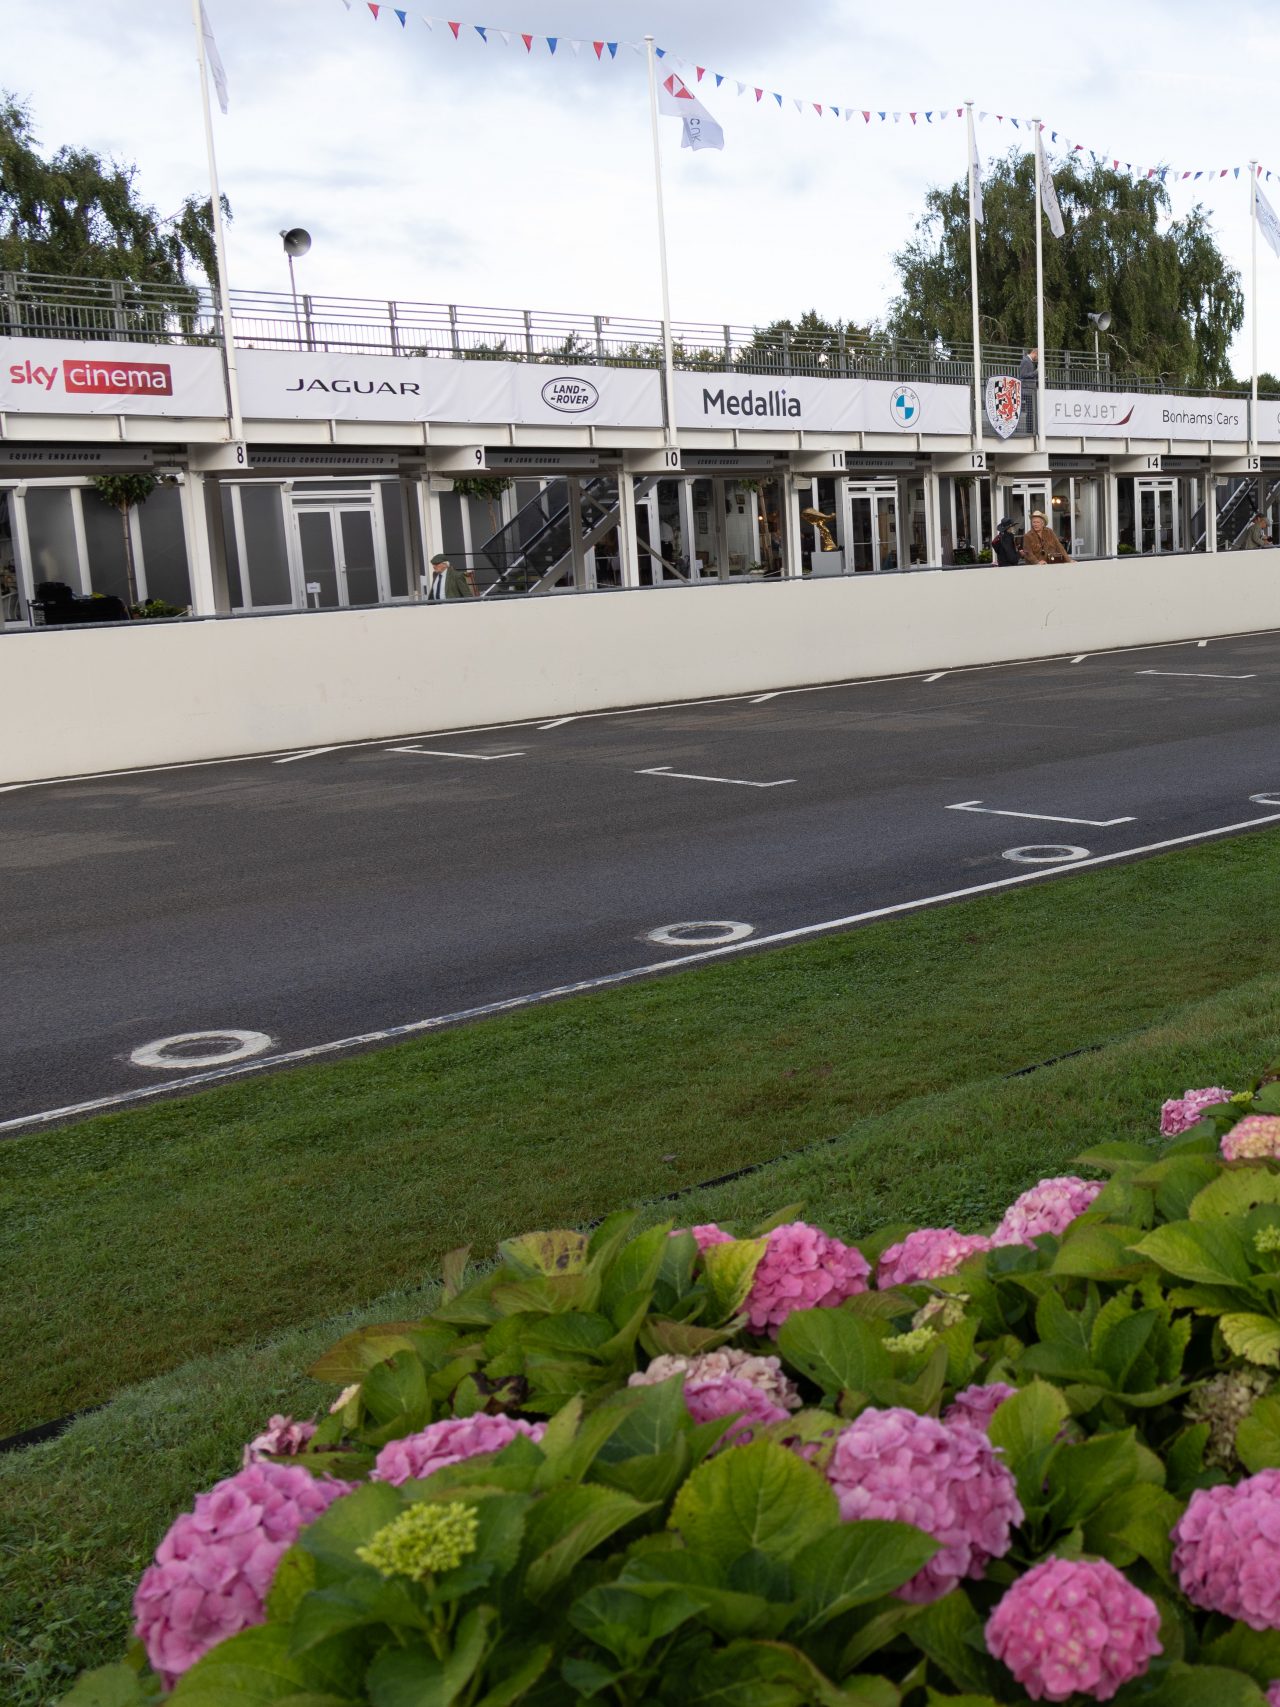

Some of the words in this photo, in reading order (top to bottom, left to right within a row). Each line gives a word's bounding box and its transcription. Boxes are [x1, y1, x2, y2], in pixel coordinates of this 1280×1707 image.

[9, 360, 58, 391] sky
[69, 364, 167, 389] cinema
[286, 378, 421, 396] JAGUAR
[553, 384, 580, 394] LAND
[556, 394, 589, 405] ROVER
[702, 388, 801, 417] Medallia
[1162, 409, 1213, 425] Bonhams
[1216, 412, 1239, 426] Cars
[9, 453, 44, 461] EQUIPE
[48, 453, 102, 461] ENDEAVOUR
[236, 446, 244, 464] 8
[475, 449, 482, 465] 9
[665, 451, 678, 467] 10
[832, 453, 843, 468] 11
[971, 454, 984, 468] 12
[1147, 456, 1159, 469] 14
[1247, 458, 1259, 469] 15
